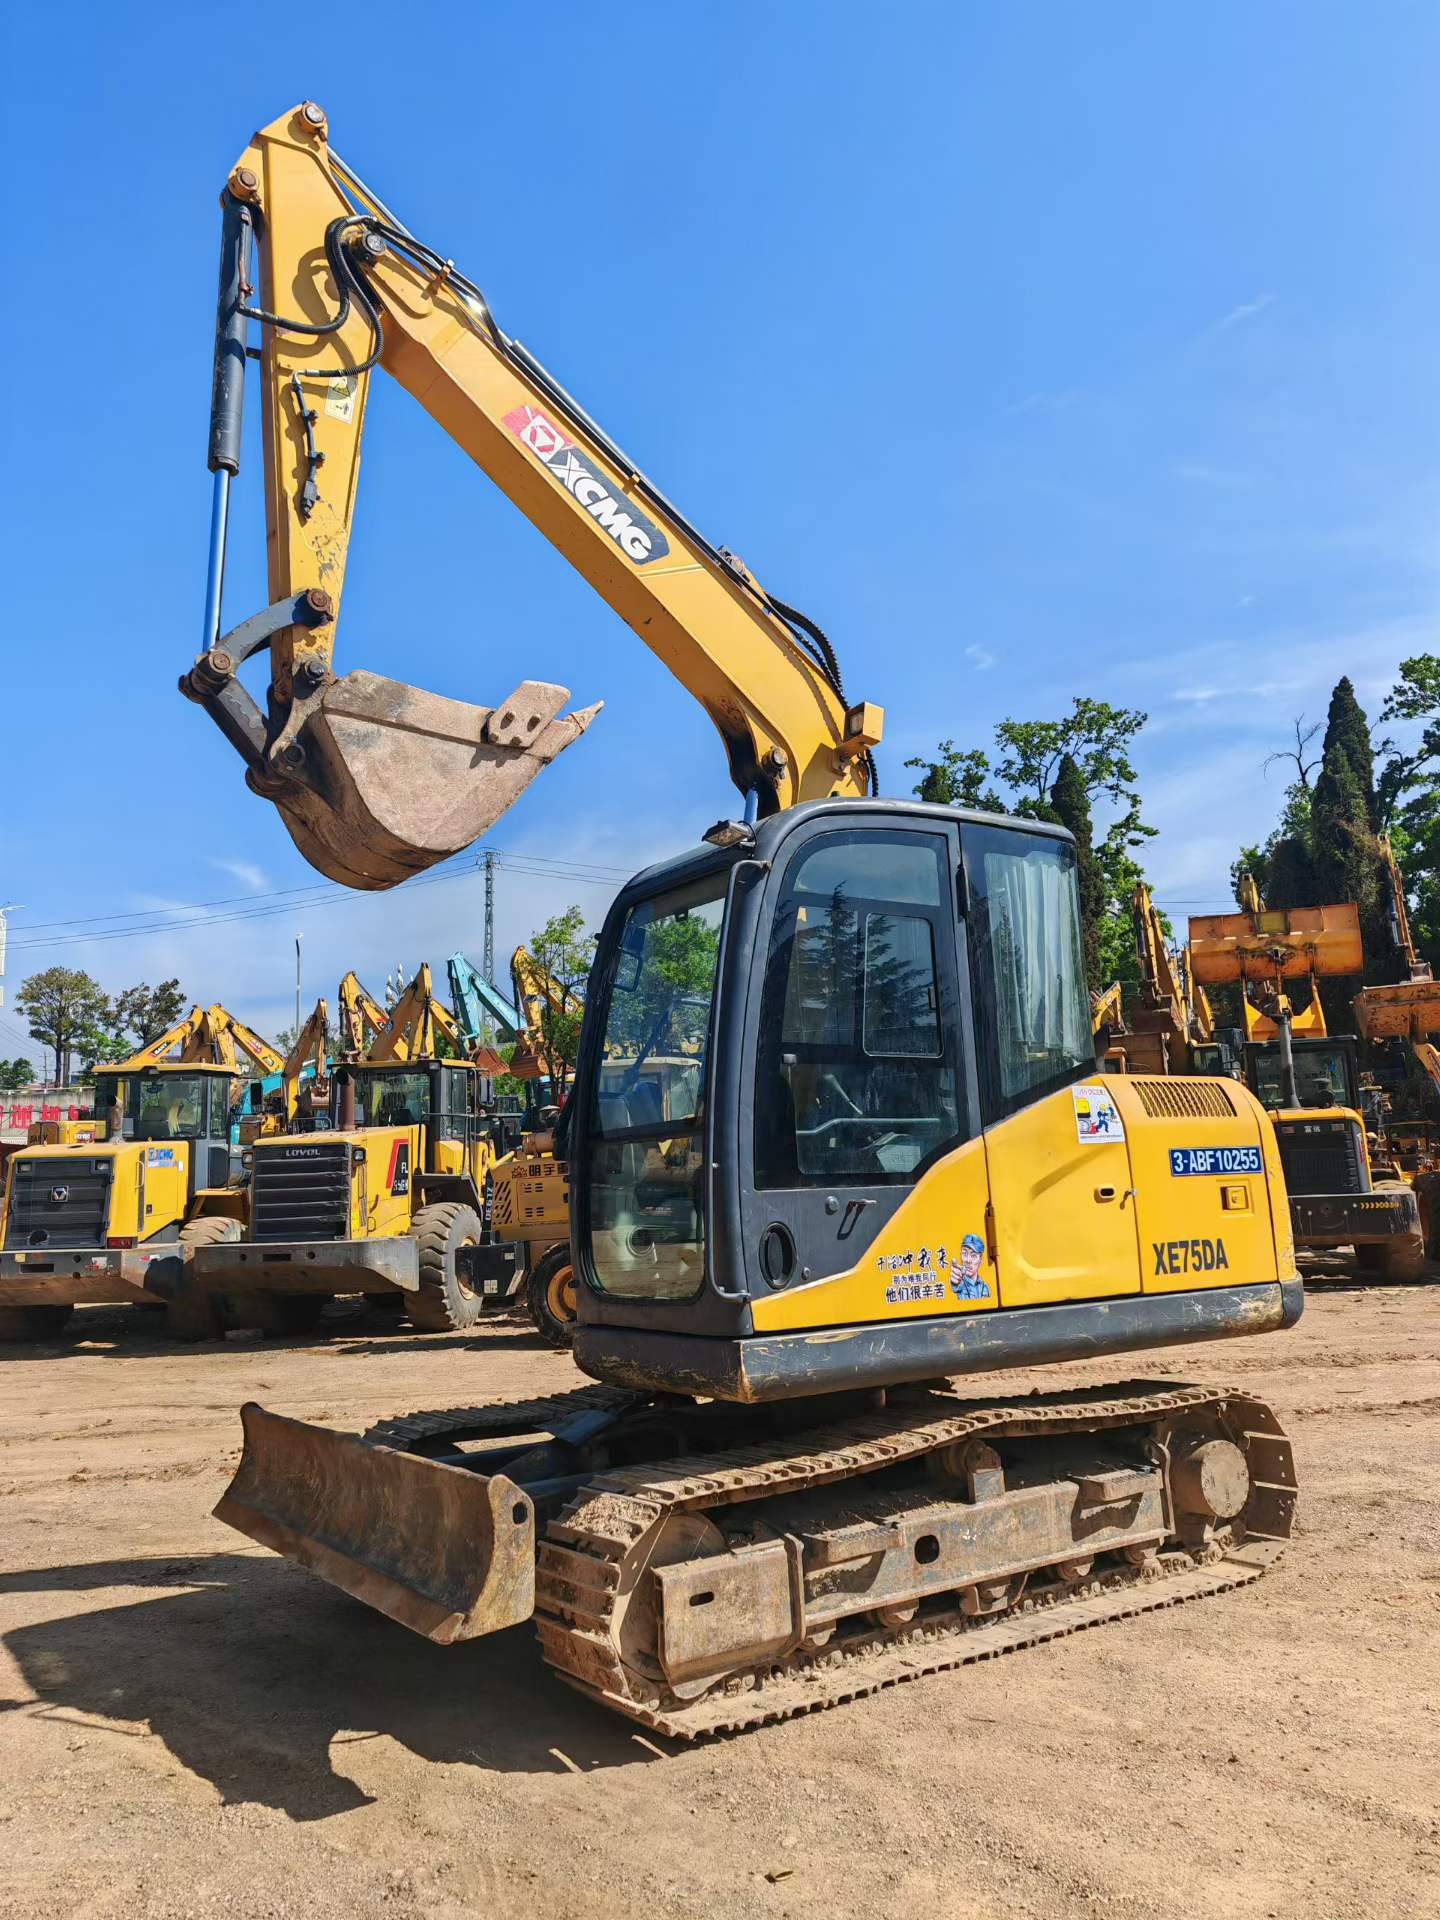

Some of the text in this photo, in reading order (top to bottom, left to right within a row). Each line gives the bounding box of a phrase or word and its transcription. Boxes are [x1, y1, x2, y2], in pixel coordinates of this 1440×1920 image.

[547, 450, 651, 559] XCMG
[1153, 1238, 1229, 1275] XE75DA
[886, 1284, 944, 1302] 他们很辛苦
